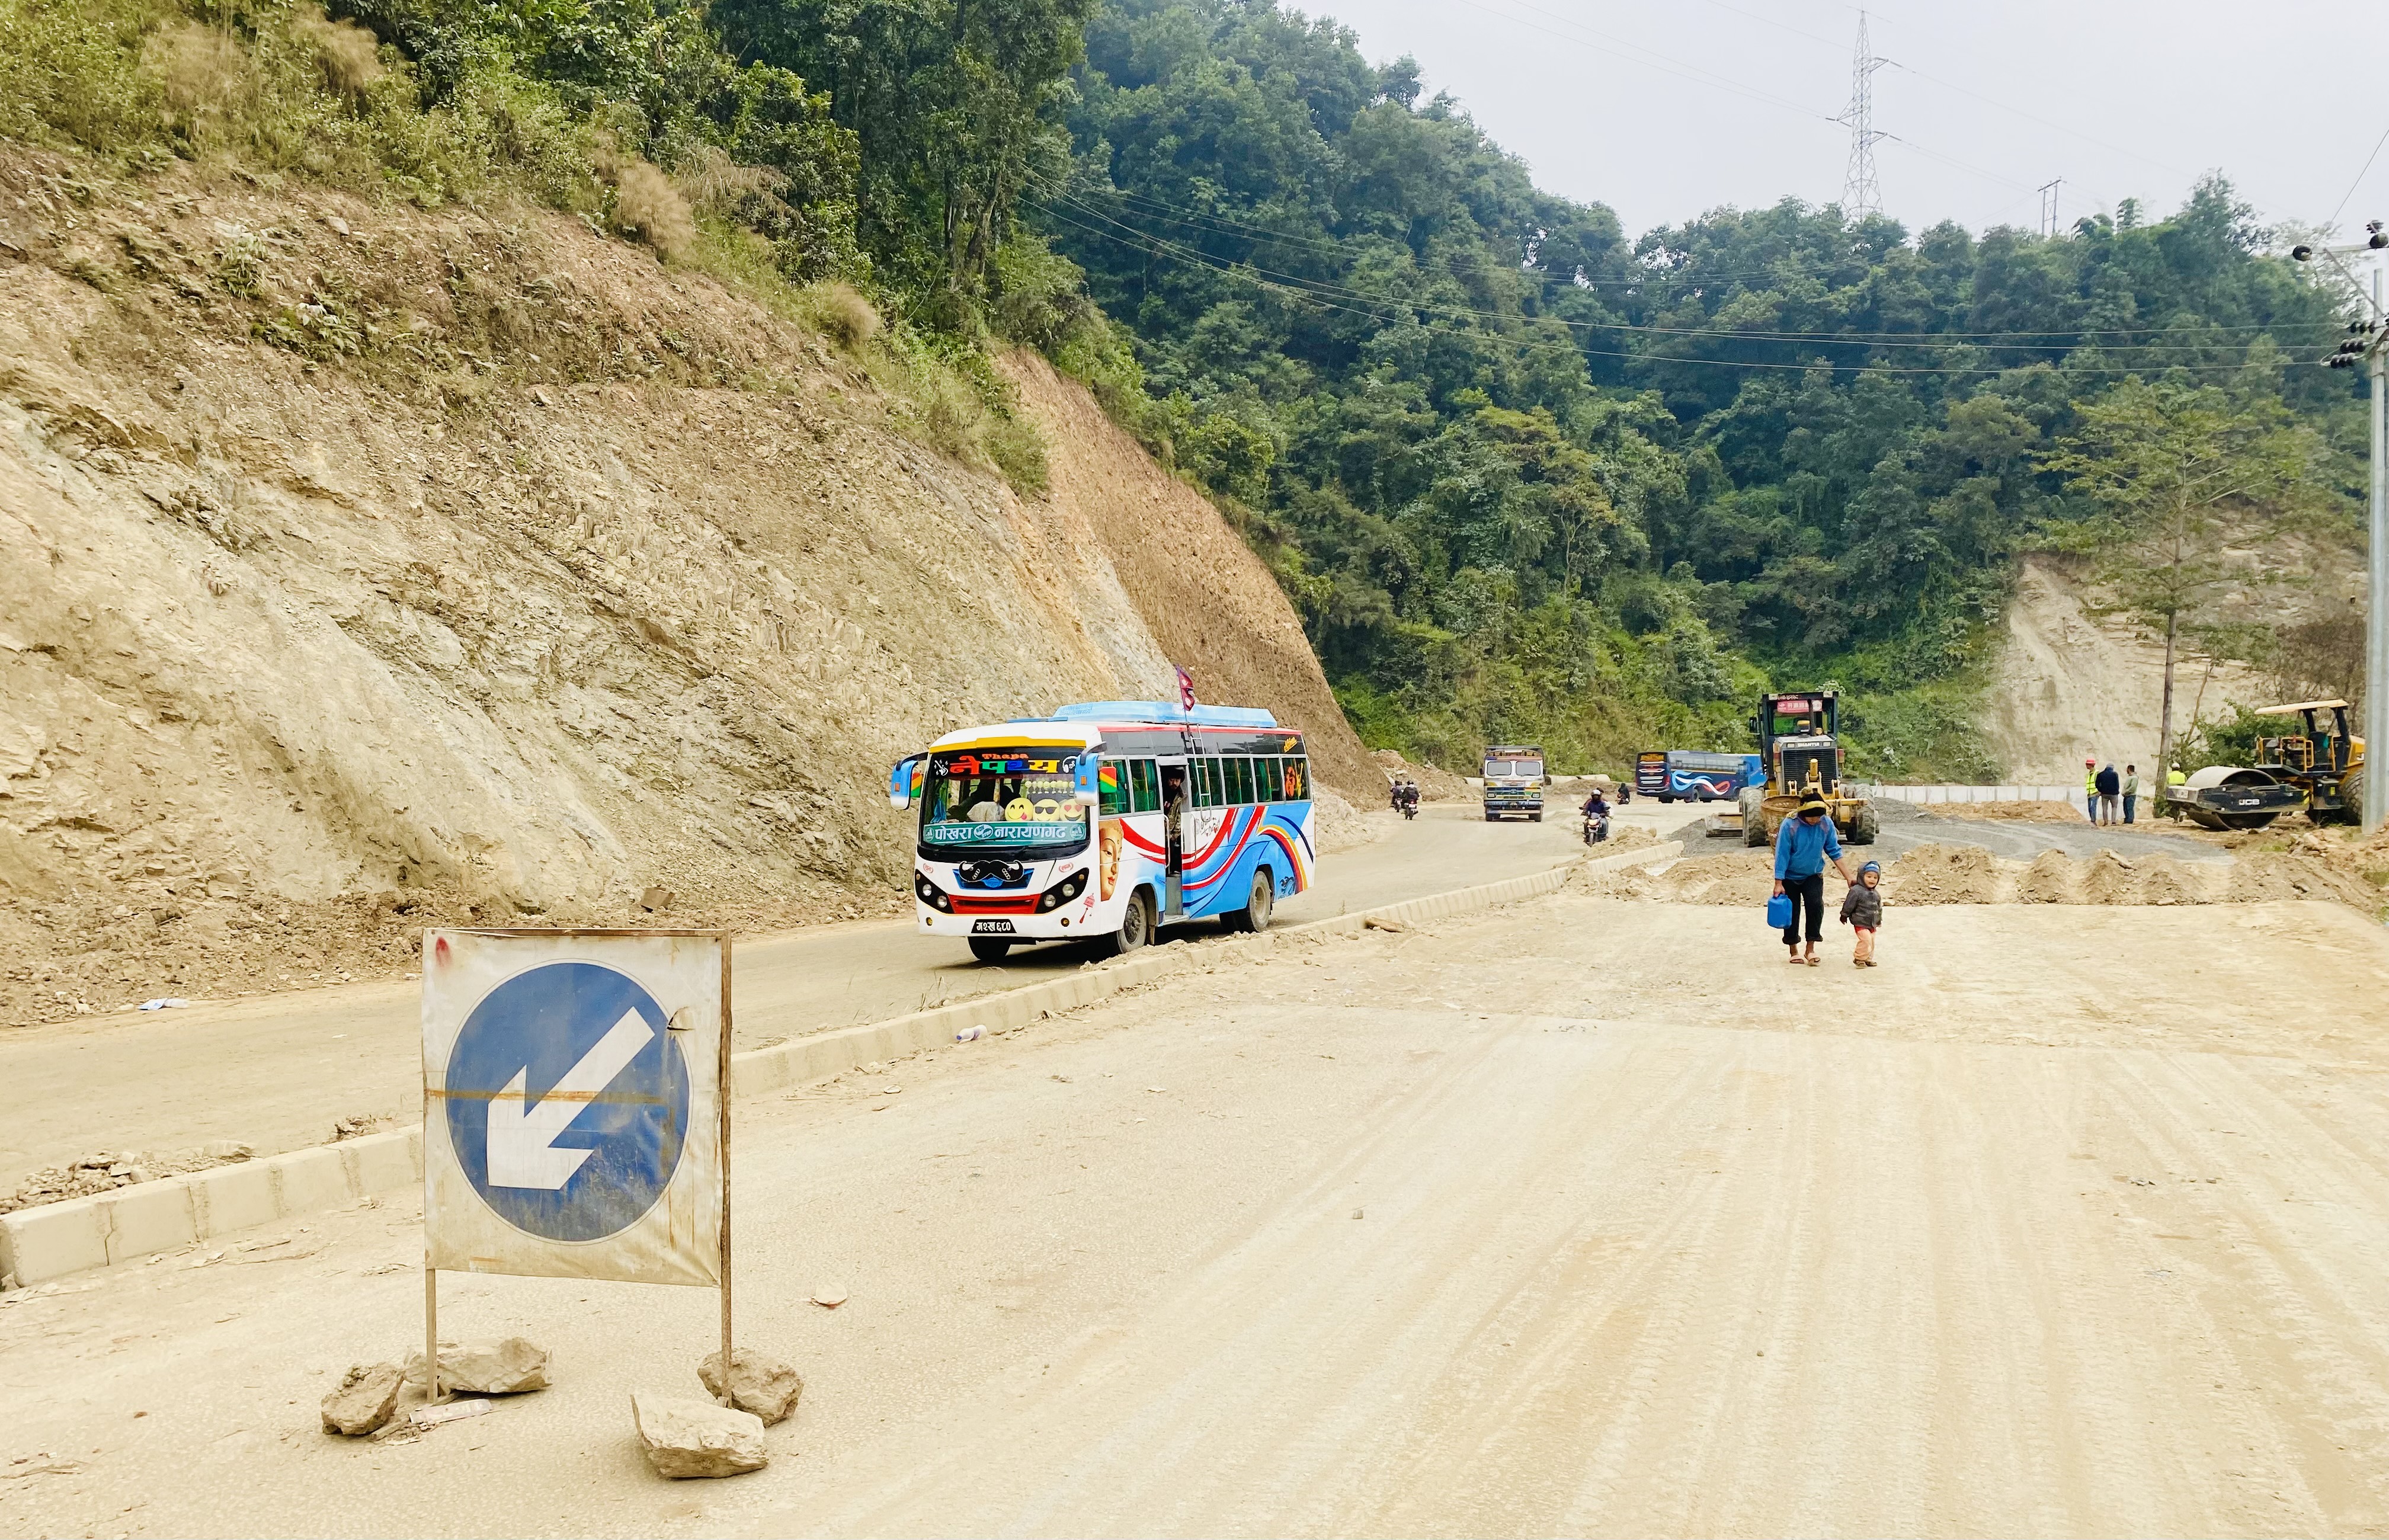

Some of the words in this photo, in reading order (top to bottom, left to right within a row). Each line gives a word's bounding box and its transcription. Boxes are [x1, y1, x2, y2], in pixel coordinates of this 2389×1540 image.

[935, 825, 973, 840] पोखरा
[994, 826, 1067, 838] नारायणगढ
[996, 921, 1011, 932] ६८०
